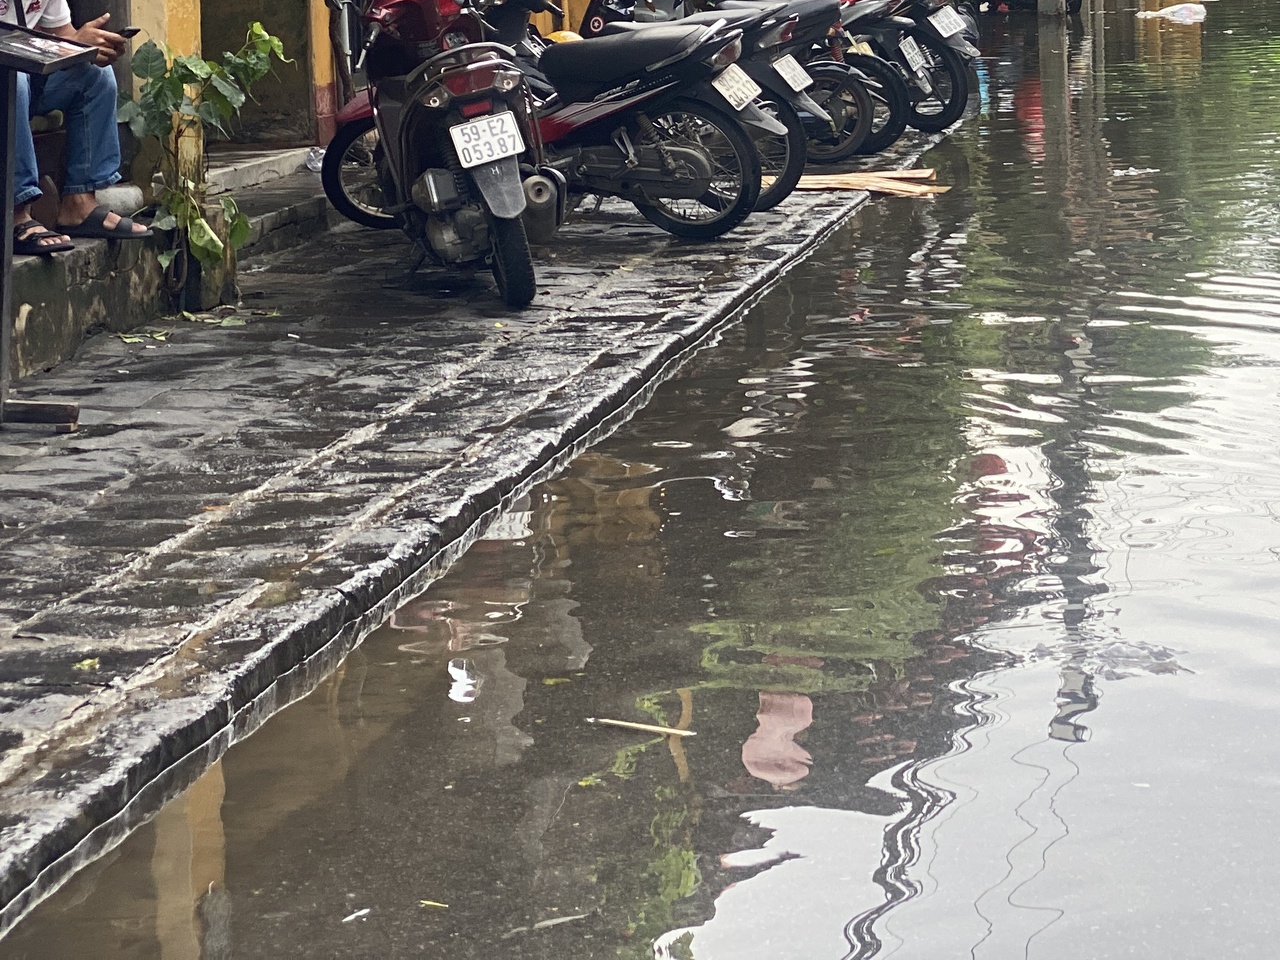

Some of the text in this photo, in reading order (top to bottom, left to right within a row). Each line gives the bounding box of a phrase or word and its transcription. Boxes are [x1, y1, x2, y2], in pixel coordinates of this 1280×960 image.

[718, 67, 743, 92] 92-E1
[460, 118, 508, 144] 59-E2
[461, 134, 516, 164] 053.87
